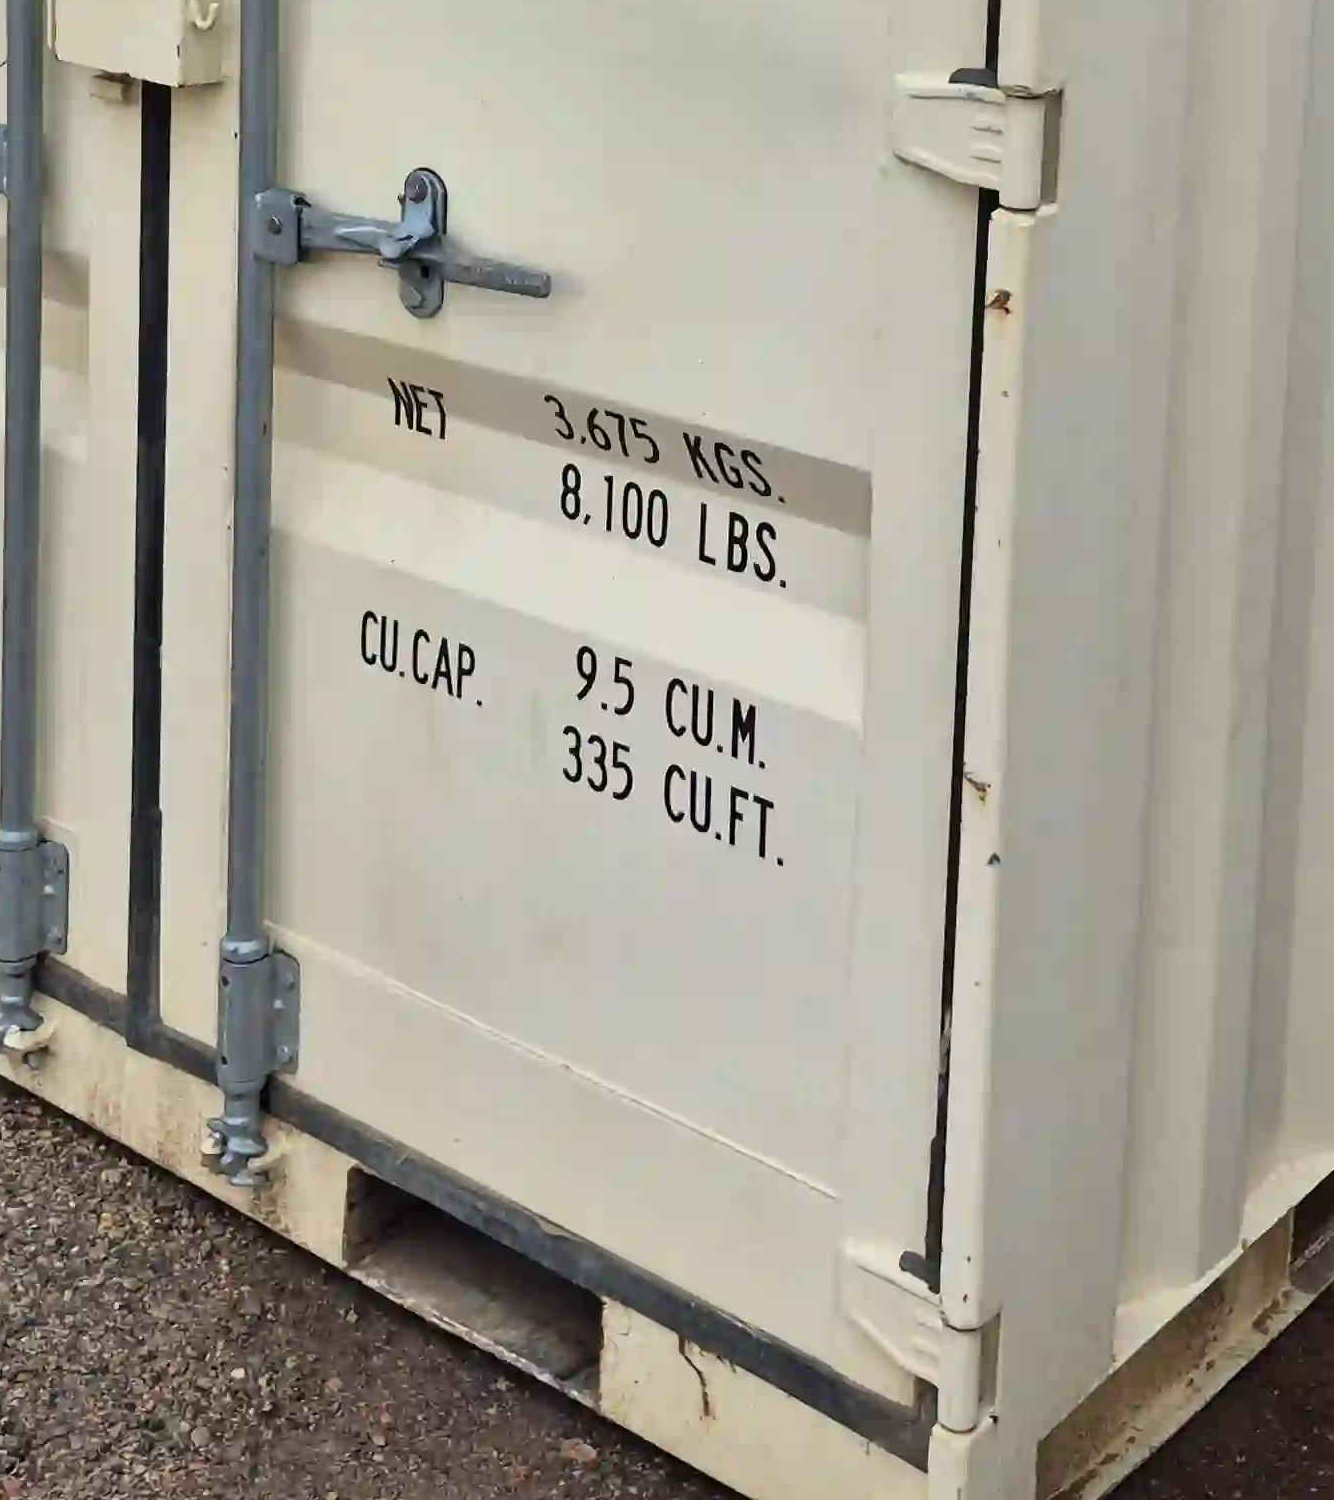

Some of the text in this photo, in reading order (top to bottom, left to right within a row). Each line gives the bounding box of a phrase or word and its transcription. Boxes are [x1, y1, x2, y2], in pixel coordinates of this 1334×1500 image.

[387, 377, 447, 440] NET
[682, 431, 786, 504] KGS.
[560, 462, 787, 589] 8,100 LBS.
[360, 610, 766, 769] CU.CAP. 9.5 CU.M.
[562, 725, 784, 867] 335 CU.FT.
